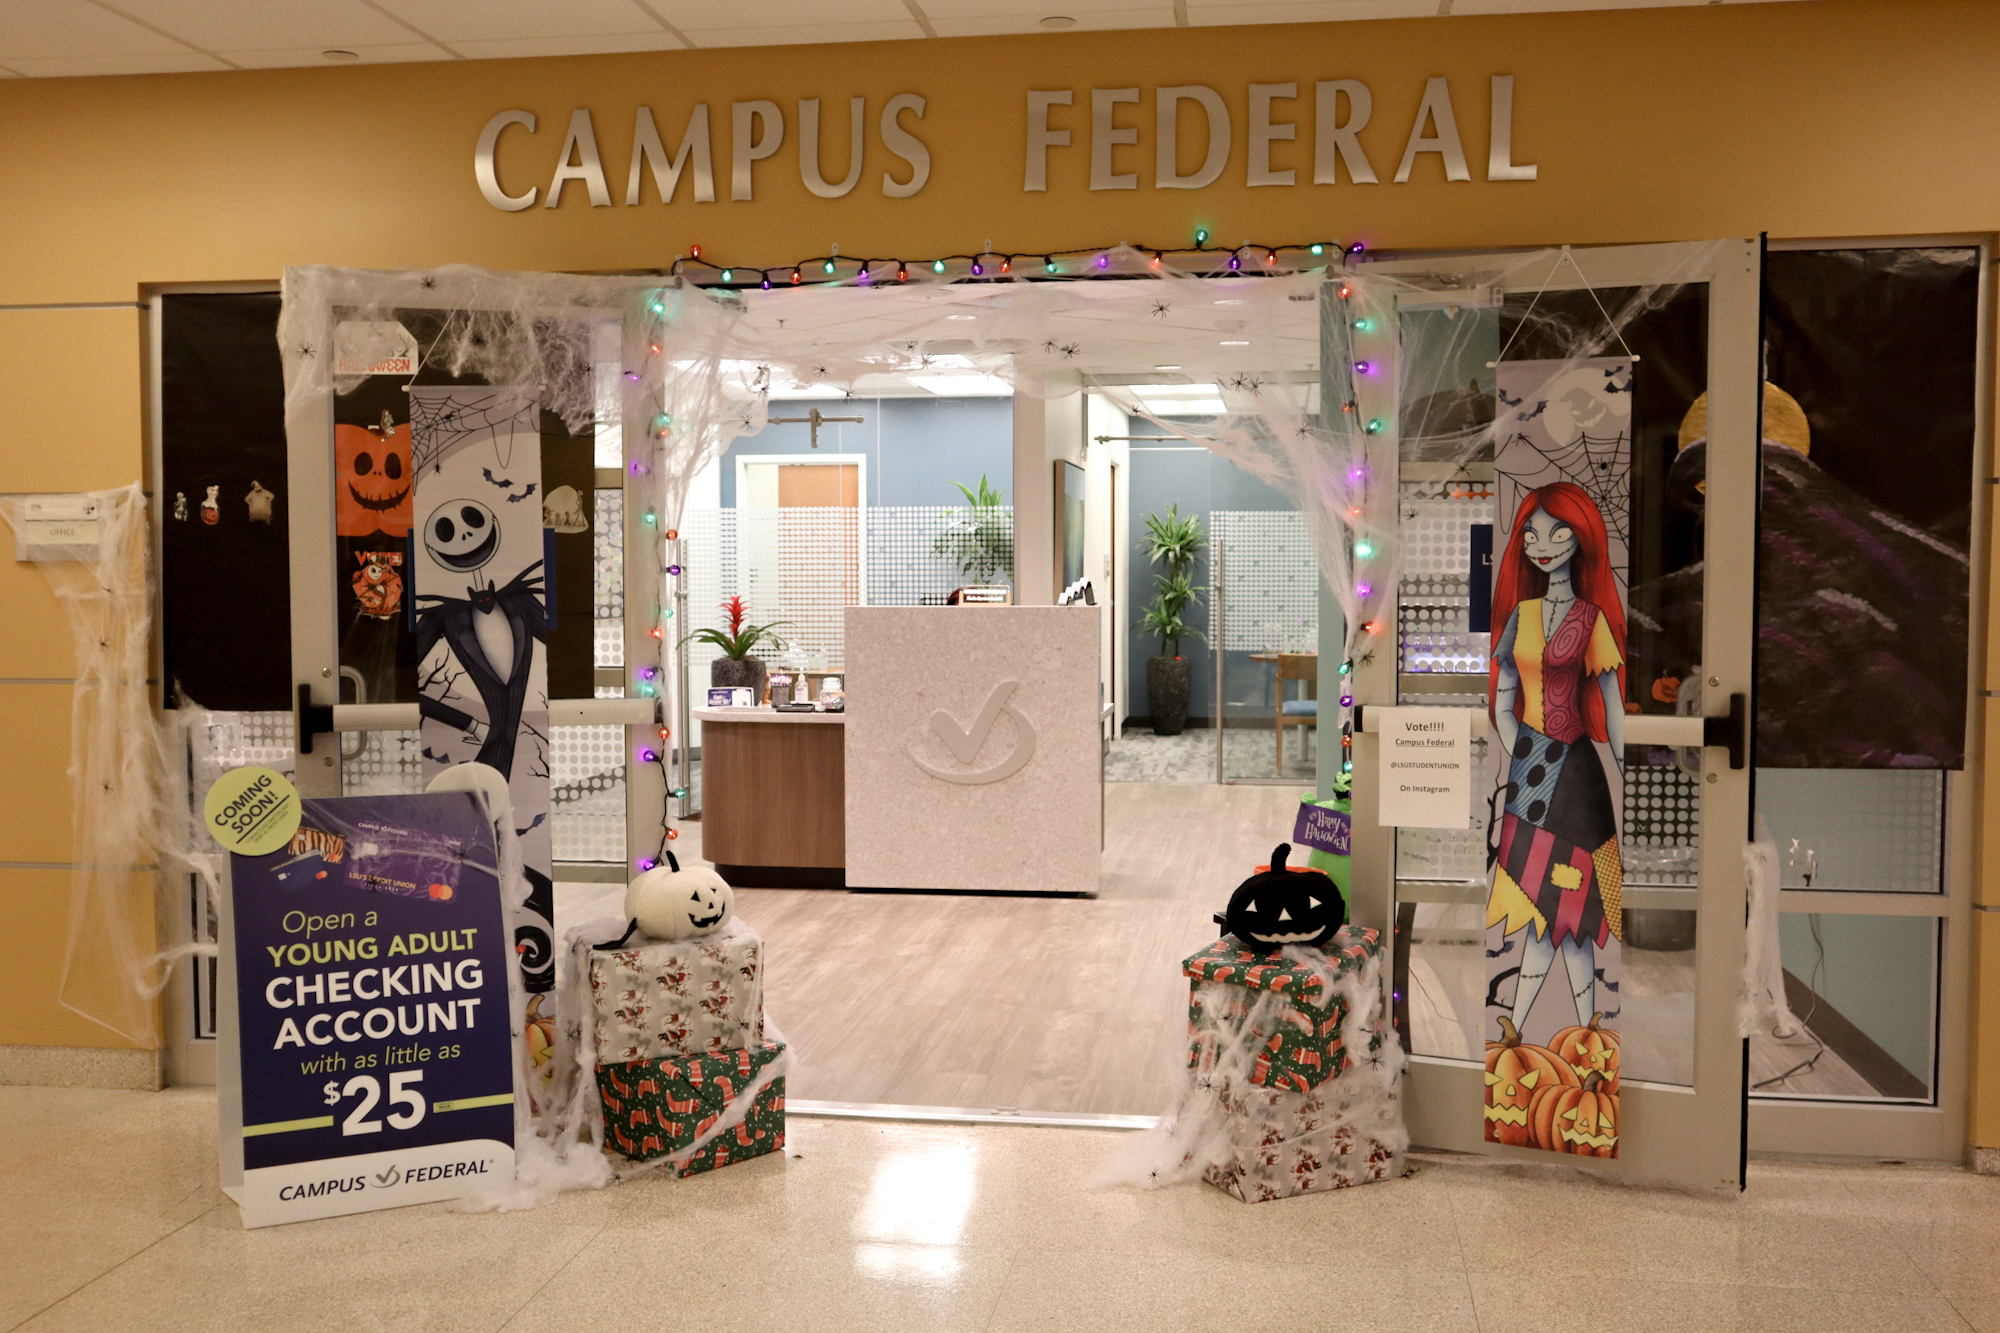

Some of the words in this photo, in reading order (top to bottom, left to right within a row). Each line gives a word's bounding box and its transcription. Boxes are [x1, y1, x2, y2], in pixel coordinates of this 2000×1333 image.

[474, 92, 931, 212] CAMPUS
[1023, 74, 1539, 192] FEDERAL
[49, 528, 76, 537] OFFICE
[1405, 722, 1445, 732] Vote!!!!
[1395, 738, 1425, 747] Campus
[1427, 738, 1455, 747] Federal
[1390, 761, 1460, 770] @LSUSTUDENTUNION
[214, 774, 273, 827] COMING
[1400, 784, 1411, 792] On
[1412, 785, 1451, 794] Instagram
[231, 790, 279, 834] SOON!
[358, 822, 380, 830] CAMPUS
[393, 878, 417, 889] UNION
[282, 910, 355, 939] Open
[364, 911, 378, 927] a
[266, 937, 379, 968] YOUNG
[387, 928, 478, 957] ADULT
[265, 958, 484, 1009] CHECKING
[273, 998, 482, 1050] ACCOUNT
[300, 1051, 347, 1075] with
[354, 1053, 378, 1069] as
[384, 1043, 432, 1066] little
[438, 1044, 462, 1059] as
[323, 1069, 427, 1137] $25
[278, 1175, 367, 1201] CAMPUS
